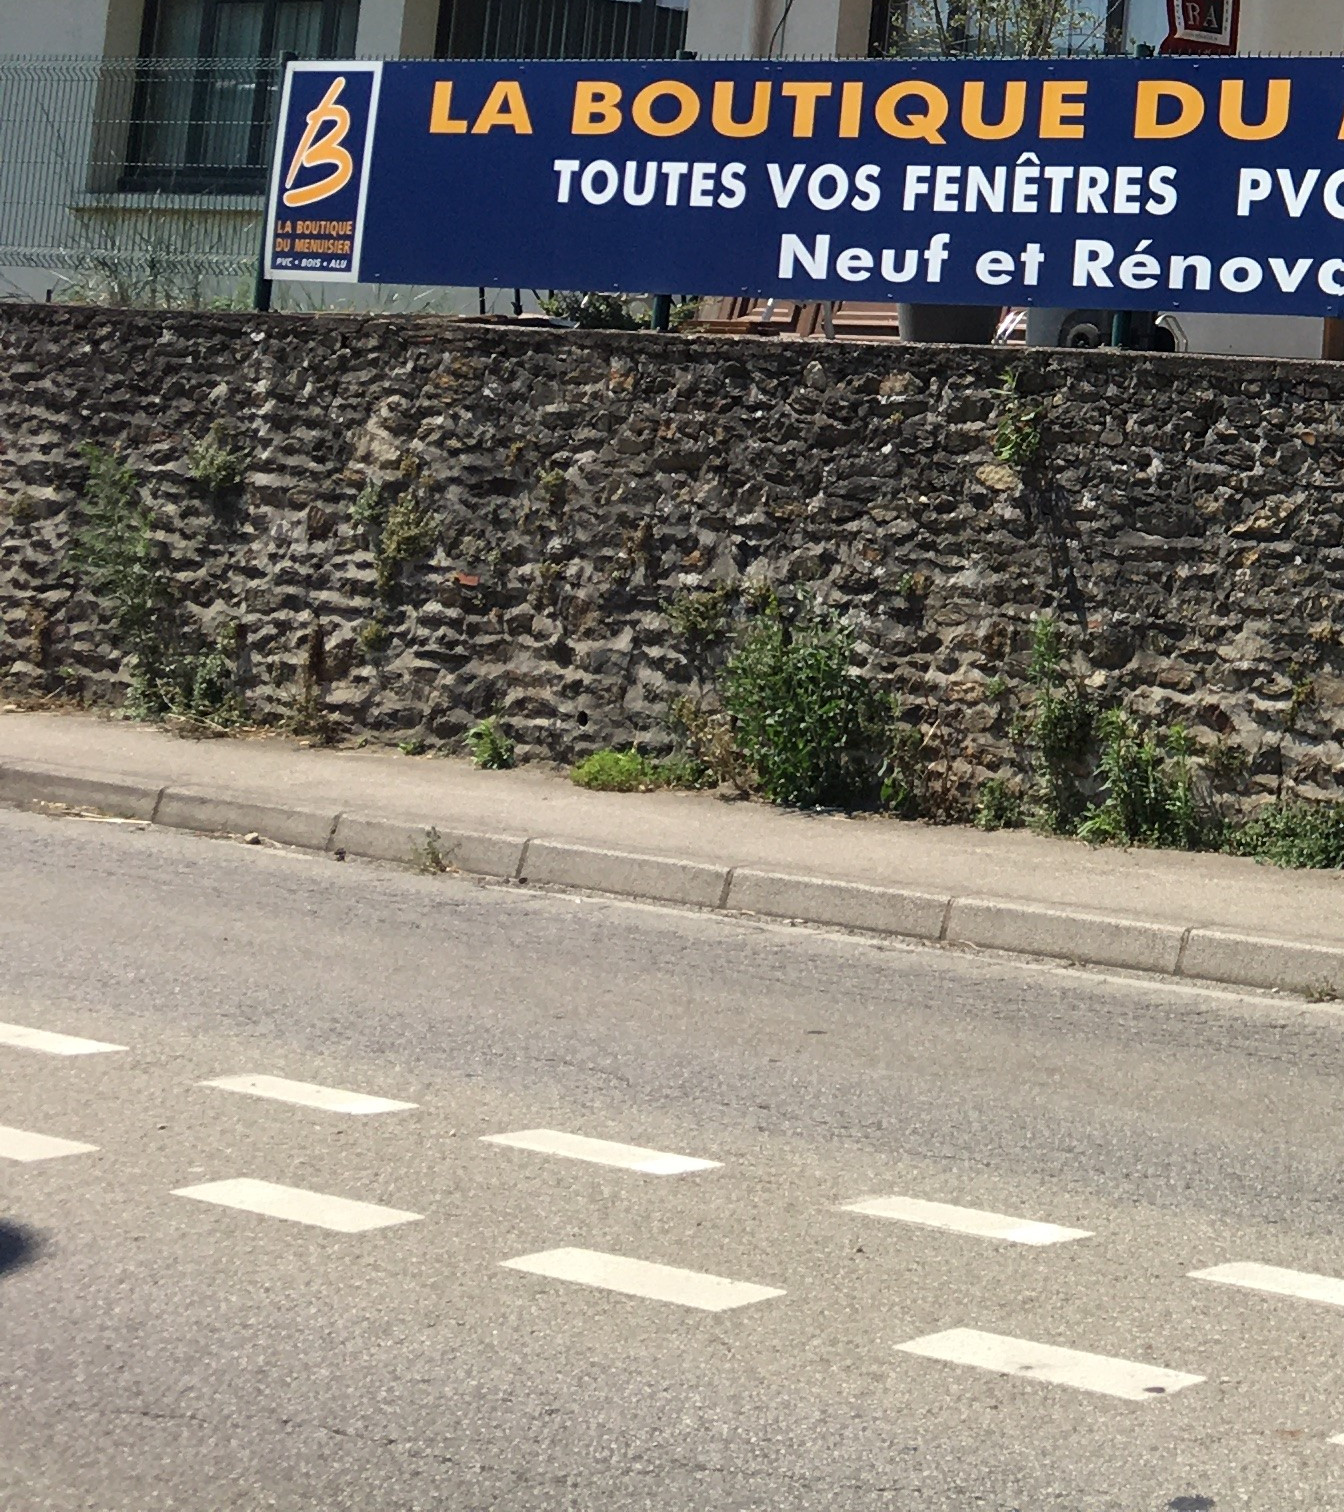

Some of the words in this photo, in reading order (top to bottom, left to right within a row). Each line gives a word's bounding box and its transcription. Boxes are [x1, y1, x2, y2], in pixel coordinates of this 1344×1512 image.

[429, 80, 533, 134] LA
[571, 80, 1088, 145] BOUTIQUE
[1133, 79, 1291, 140] DU
[553, 159, 747, 209] TOUTES
[766, 163, 881, 211] VOS
[902, 151, 1178, 216] FENÊTRES
[275, 237, 290, 252] DU
[294, 239, 351, 254] MENUISIER
[276, 220, 293, 234] LA
[296, 220, 353, 236] BOUTIQUE
[275, 257, 293, 266] PVC
[300, 258, 321, 267] BOIS
[328, 259, 348, 269] ALU
[777, 232, 950, 283] Neuf
[975, 242, 1045, 286] et
